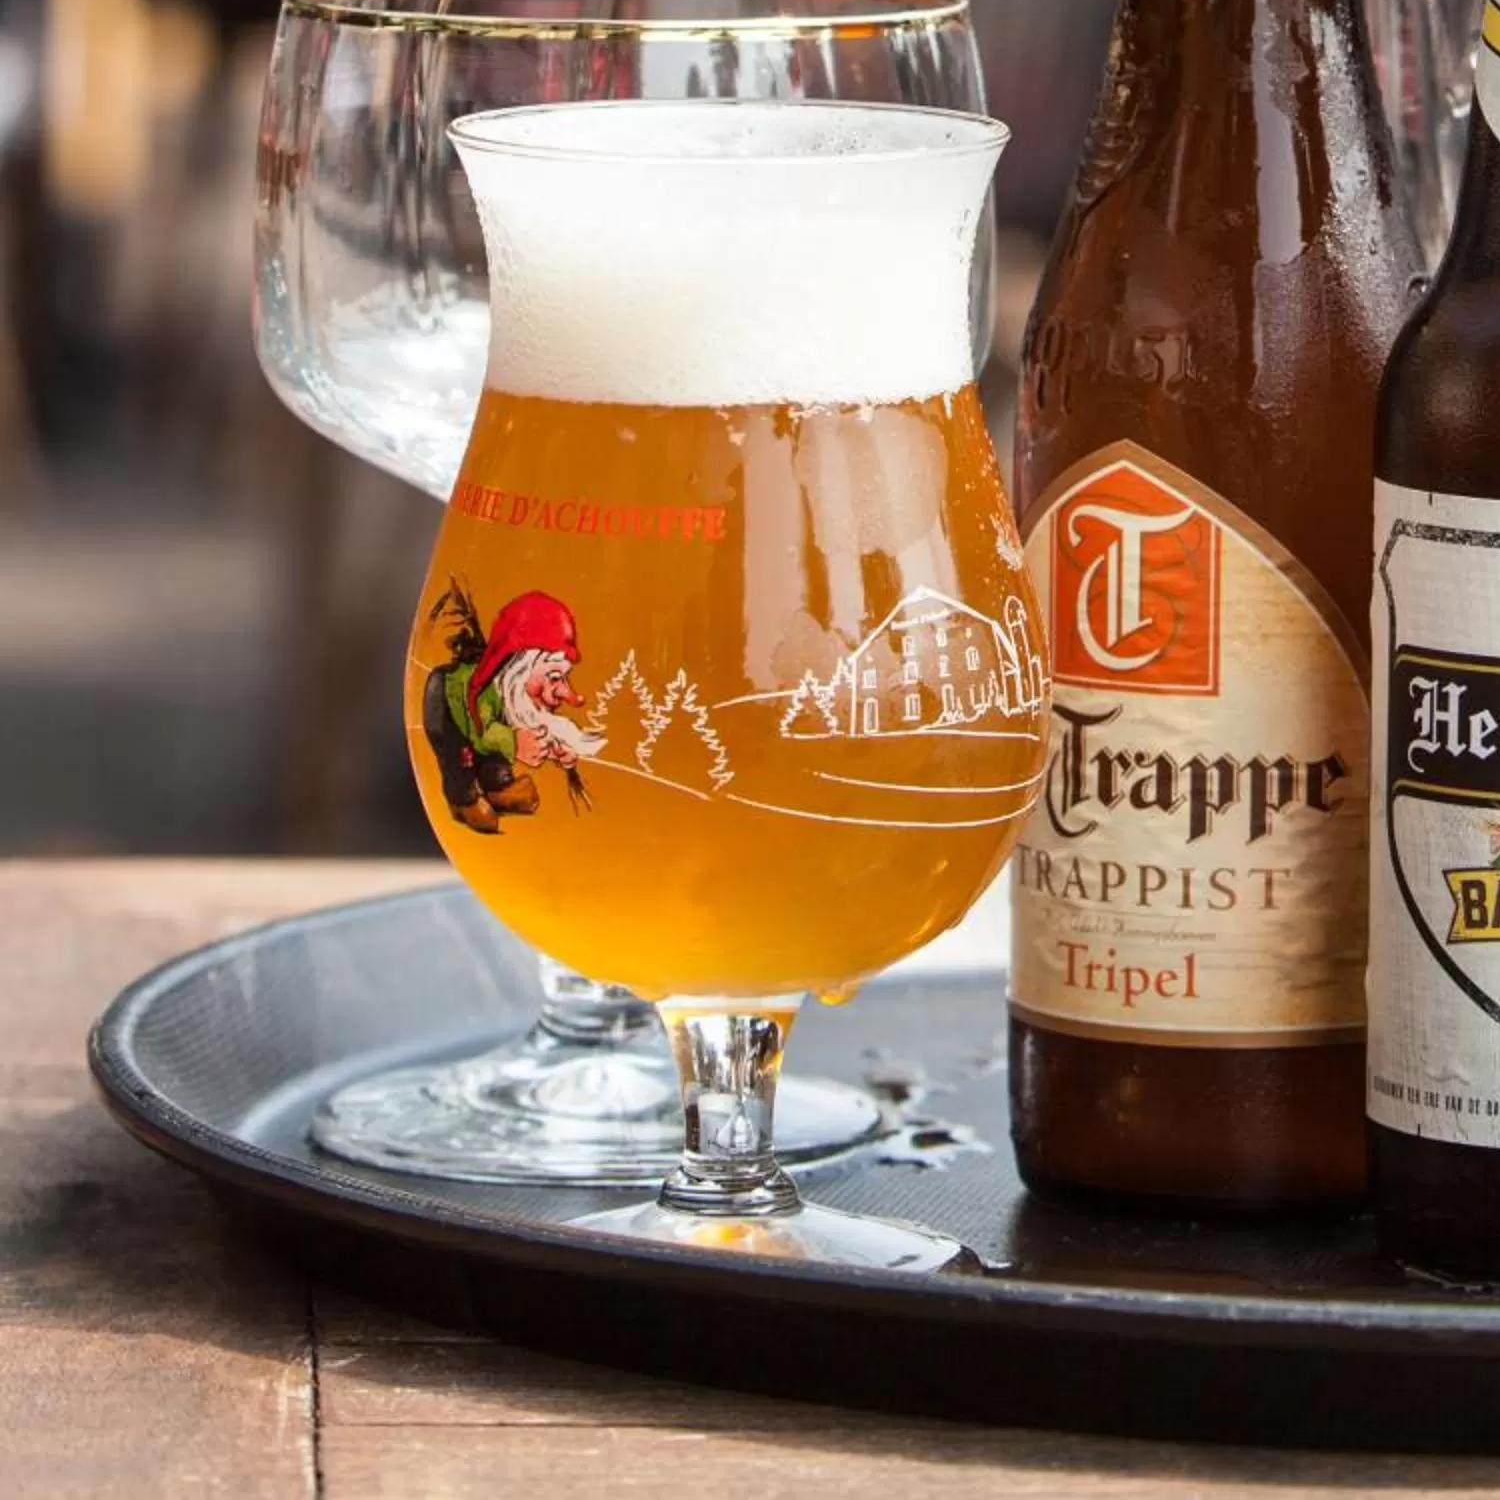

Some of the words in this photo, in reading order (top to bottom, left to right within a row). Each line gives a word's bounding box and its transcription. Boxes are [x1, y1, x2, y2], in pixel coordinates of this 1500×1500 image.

[1046, 703, 1347, 845] Trappe
[1015, 843, 1291, 912] TRAPPIST
[1057, 940, 1200, 1009] Tripel
